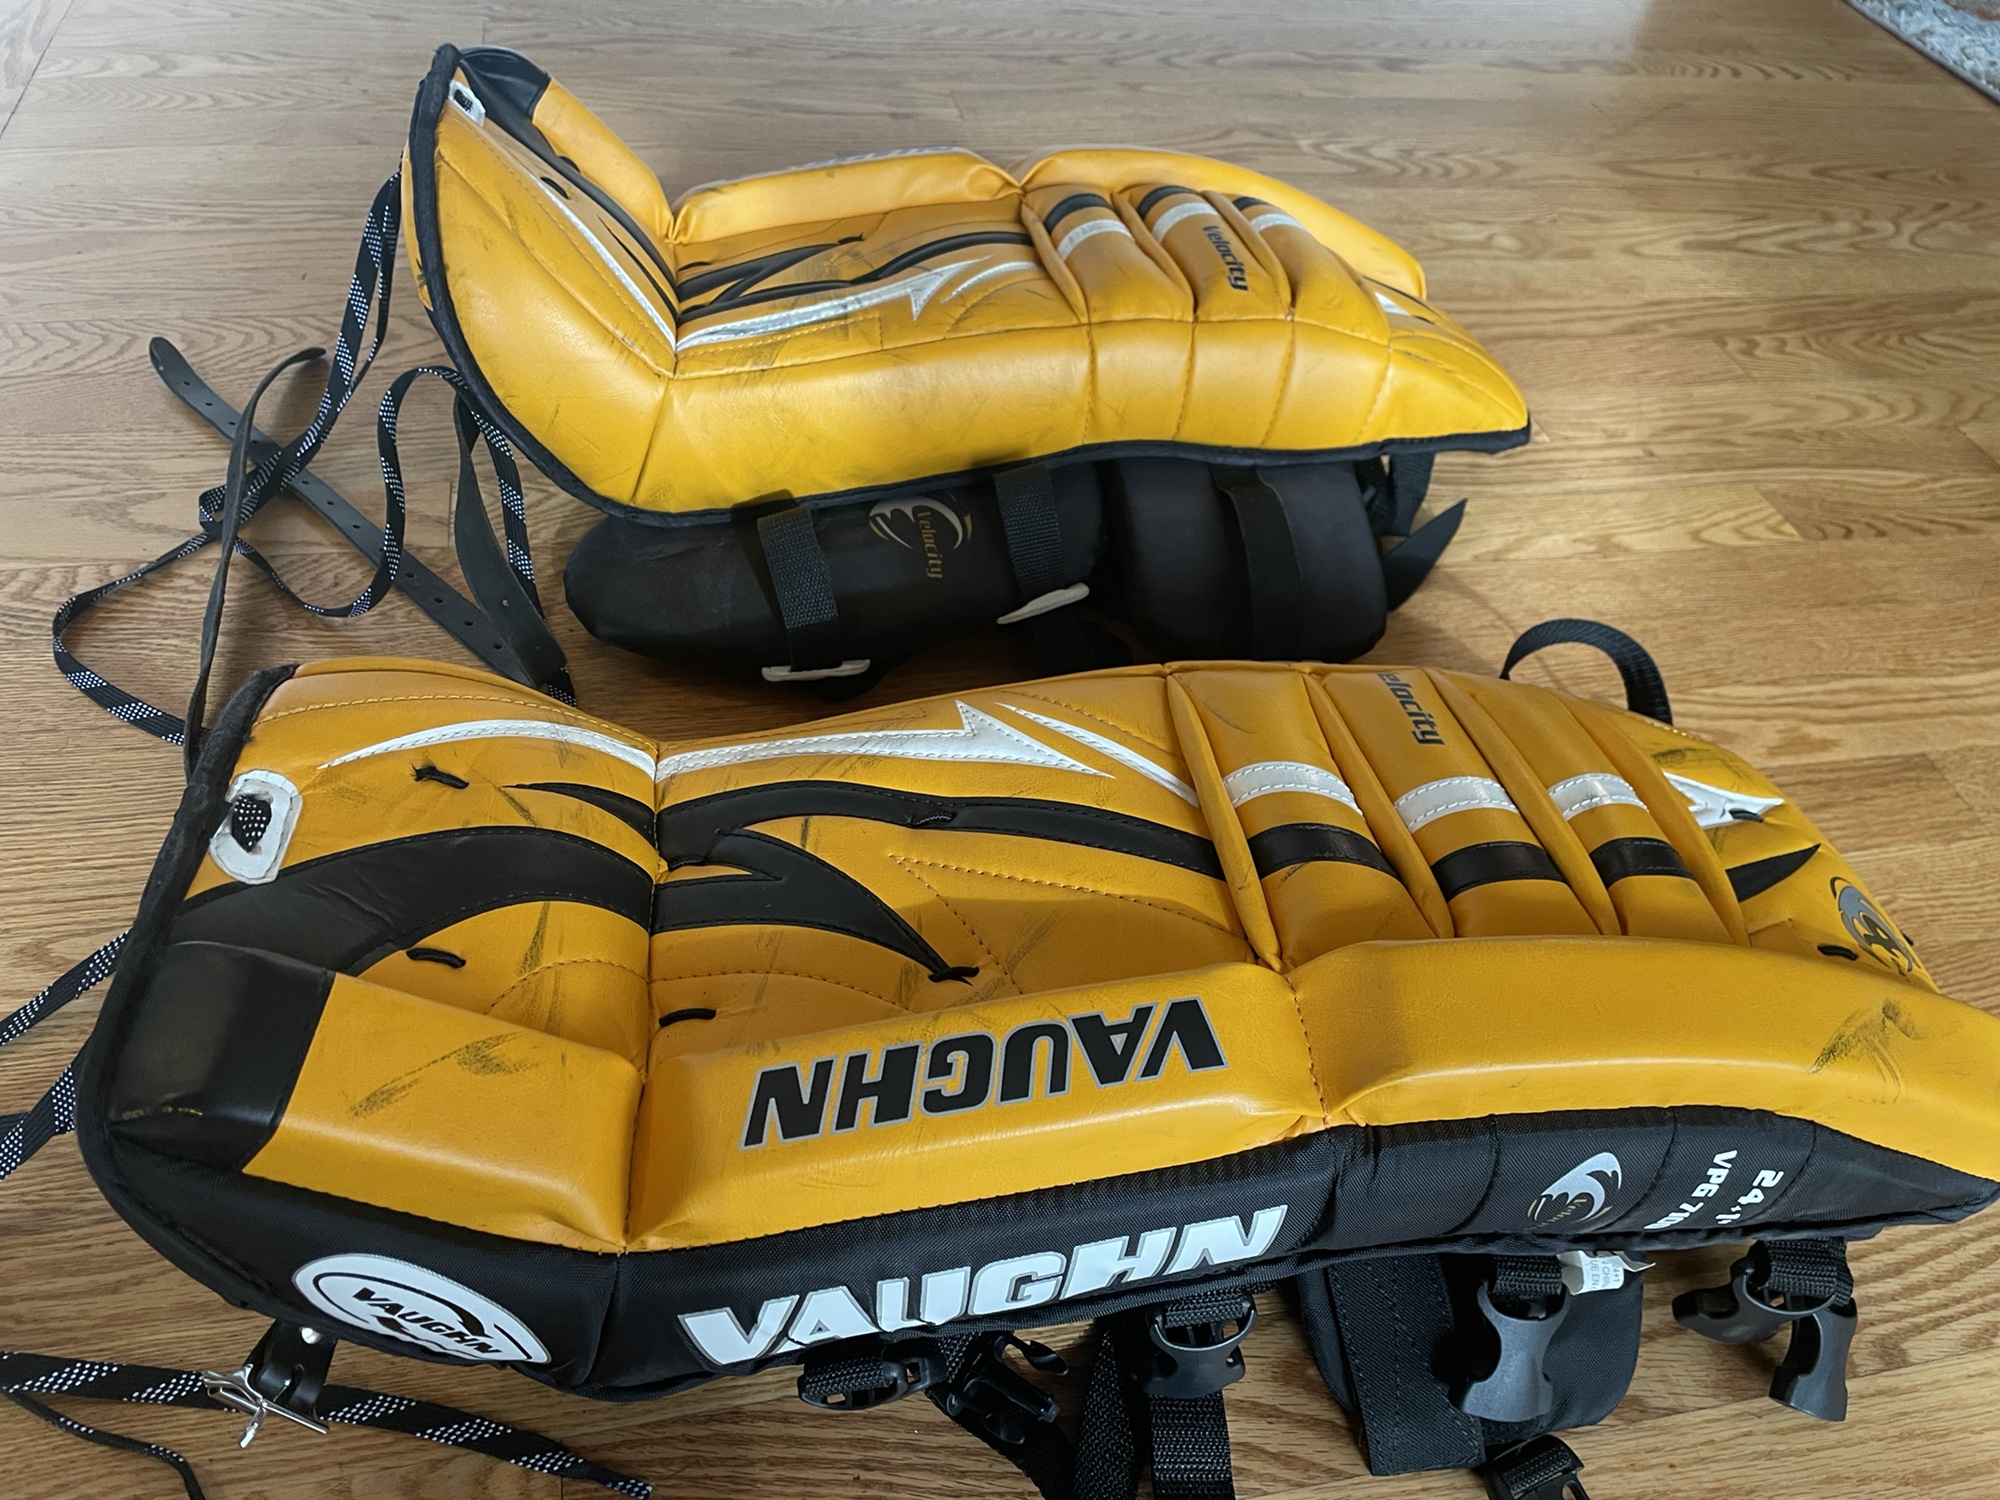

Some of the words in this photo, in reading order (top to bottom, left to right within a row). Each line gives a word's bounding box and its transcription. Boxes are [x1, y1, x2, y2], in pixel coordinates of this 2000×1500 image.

[1203, 226, 1249, 291] Velocity
[917, 511, 943, 578] Velocity
[1377, 672, 1445, 745] elocity
[739, 996, 1229, 1151] VAUGHN
[353, 1286, 502, 1355] VAUGHN
[679, 1204, 1288, 1366] VAUGHN
